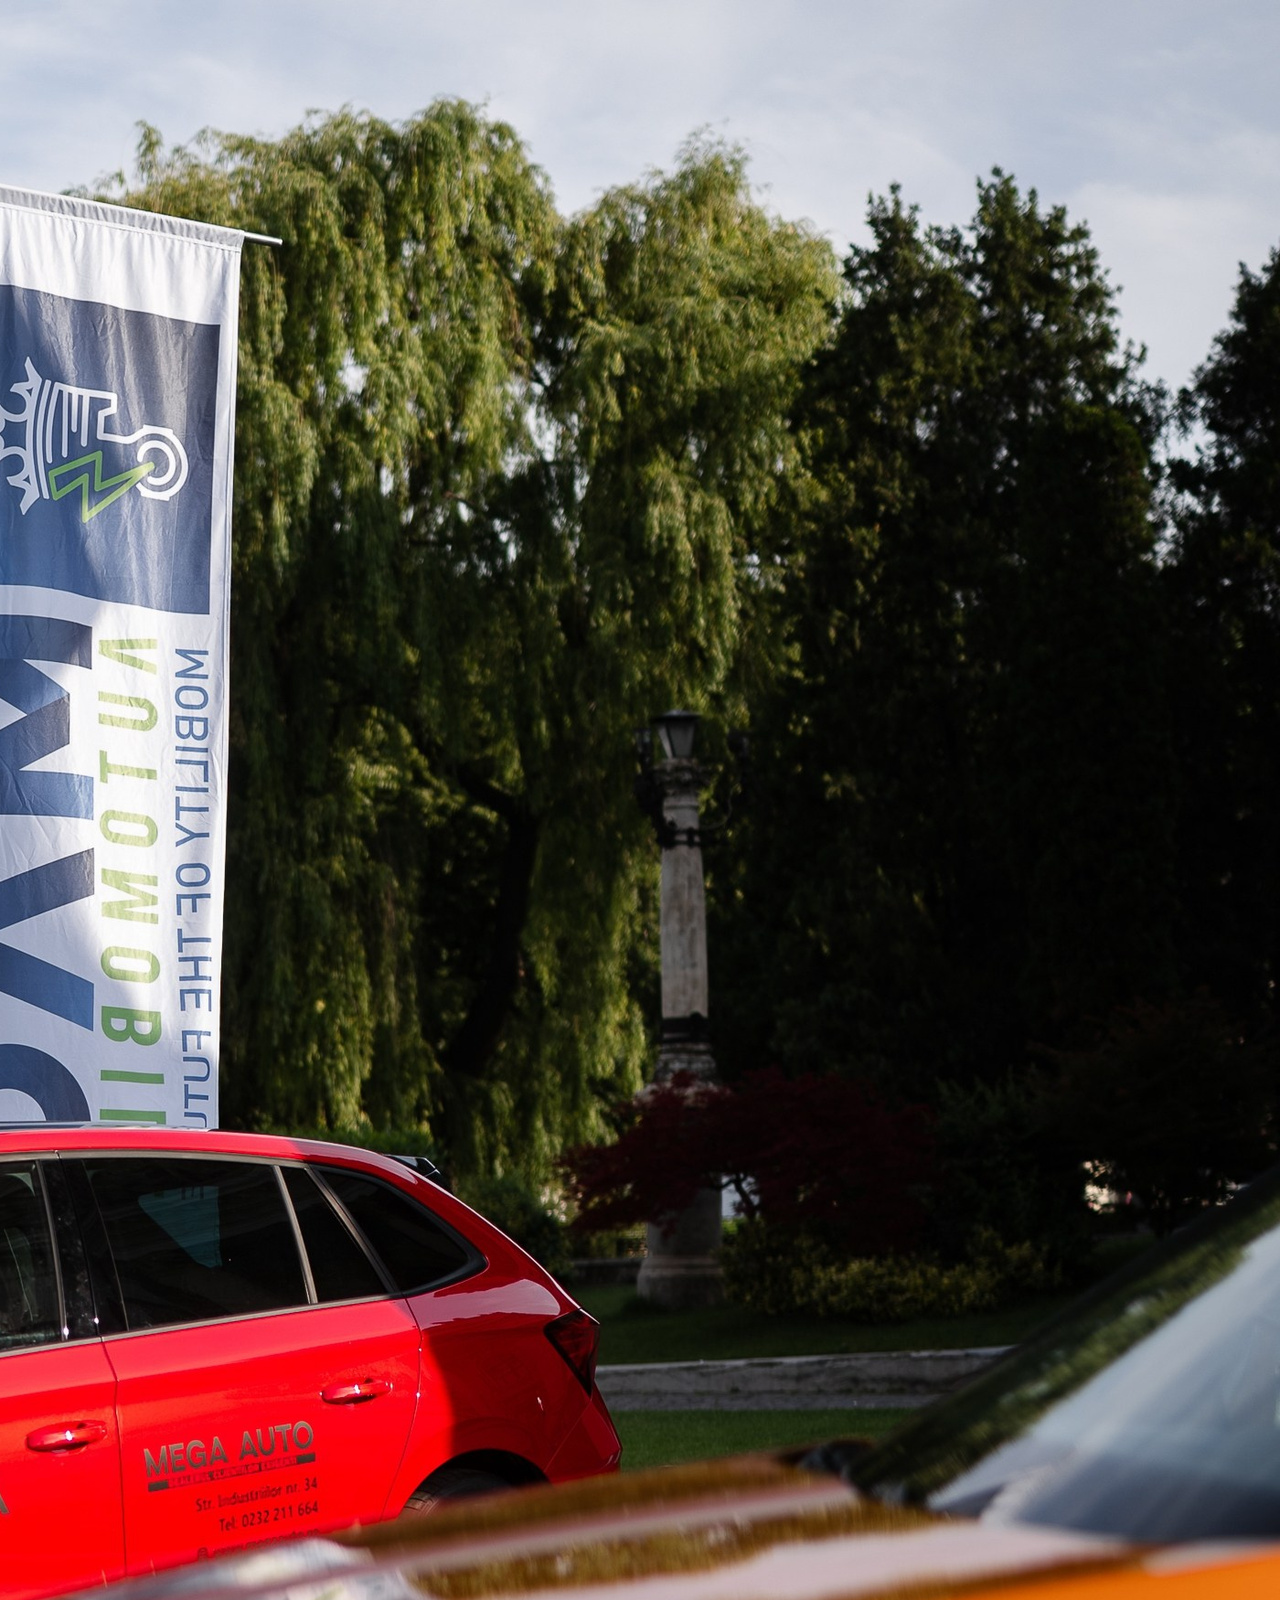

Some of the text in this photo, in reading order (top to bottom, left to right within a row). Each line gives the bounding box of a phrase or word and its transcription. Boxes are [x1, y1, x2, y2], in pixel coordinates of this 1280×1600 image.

[143, 1436, 229, 1478] MEGA
[239, 1420, 314, 1461] AUTO
[195, 1498, 215, 1513] Str.
[305, 1477, 318, 1491] 34
[242, 1509, 270, 1528] 0232
[273, 1505, 293, 1522] 211
[298, 1500, 318, 1517] 664
